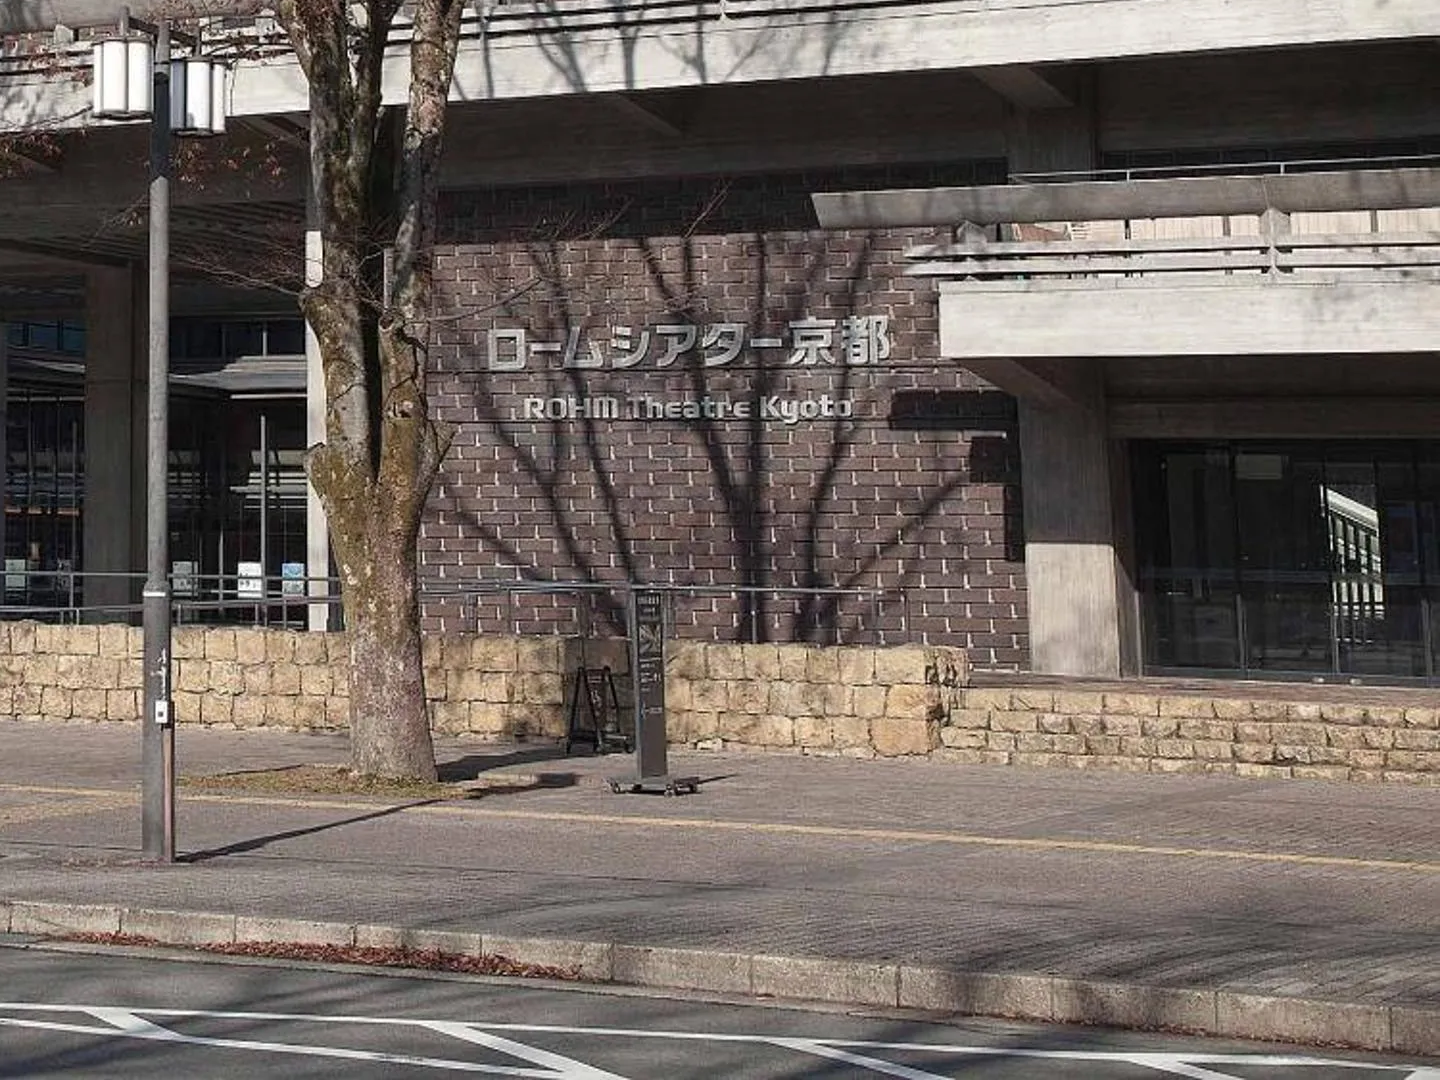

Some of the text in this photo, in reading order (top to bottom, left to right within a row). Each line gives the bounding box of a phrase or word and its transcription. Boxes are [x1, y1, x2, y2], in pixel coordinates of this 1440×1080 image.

[488, 316, 890, 370] ロームシアター京都
[524, 394, 852, 424] ROHM Theatre Kyoto
